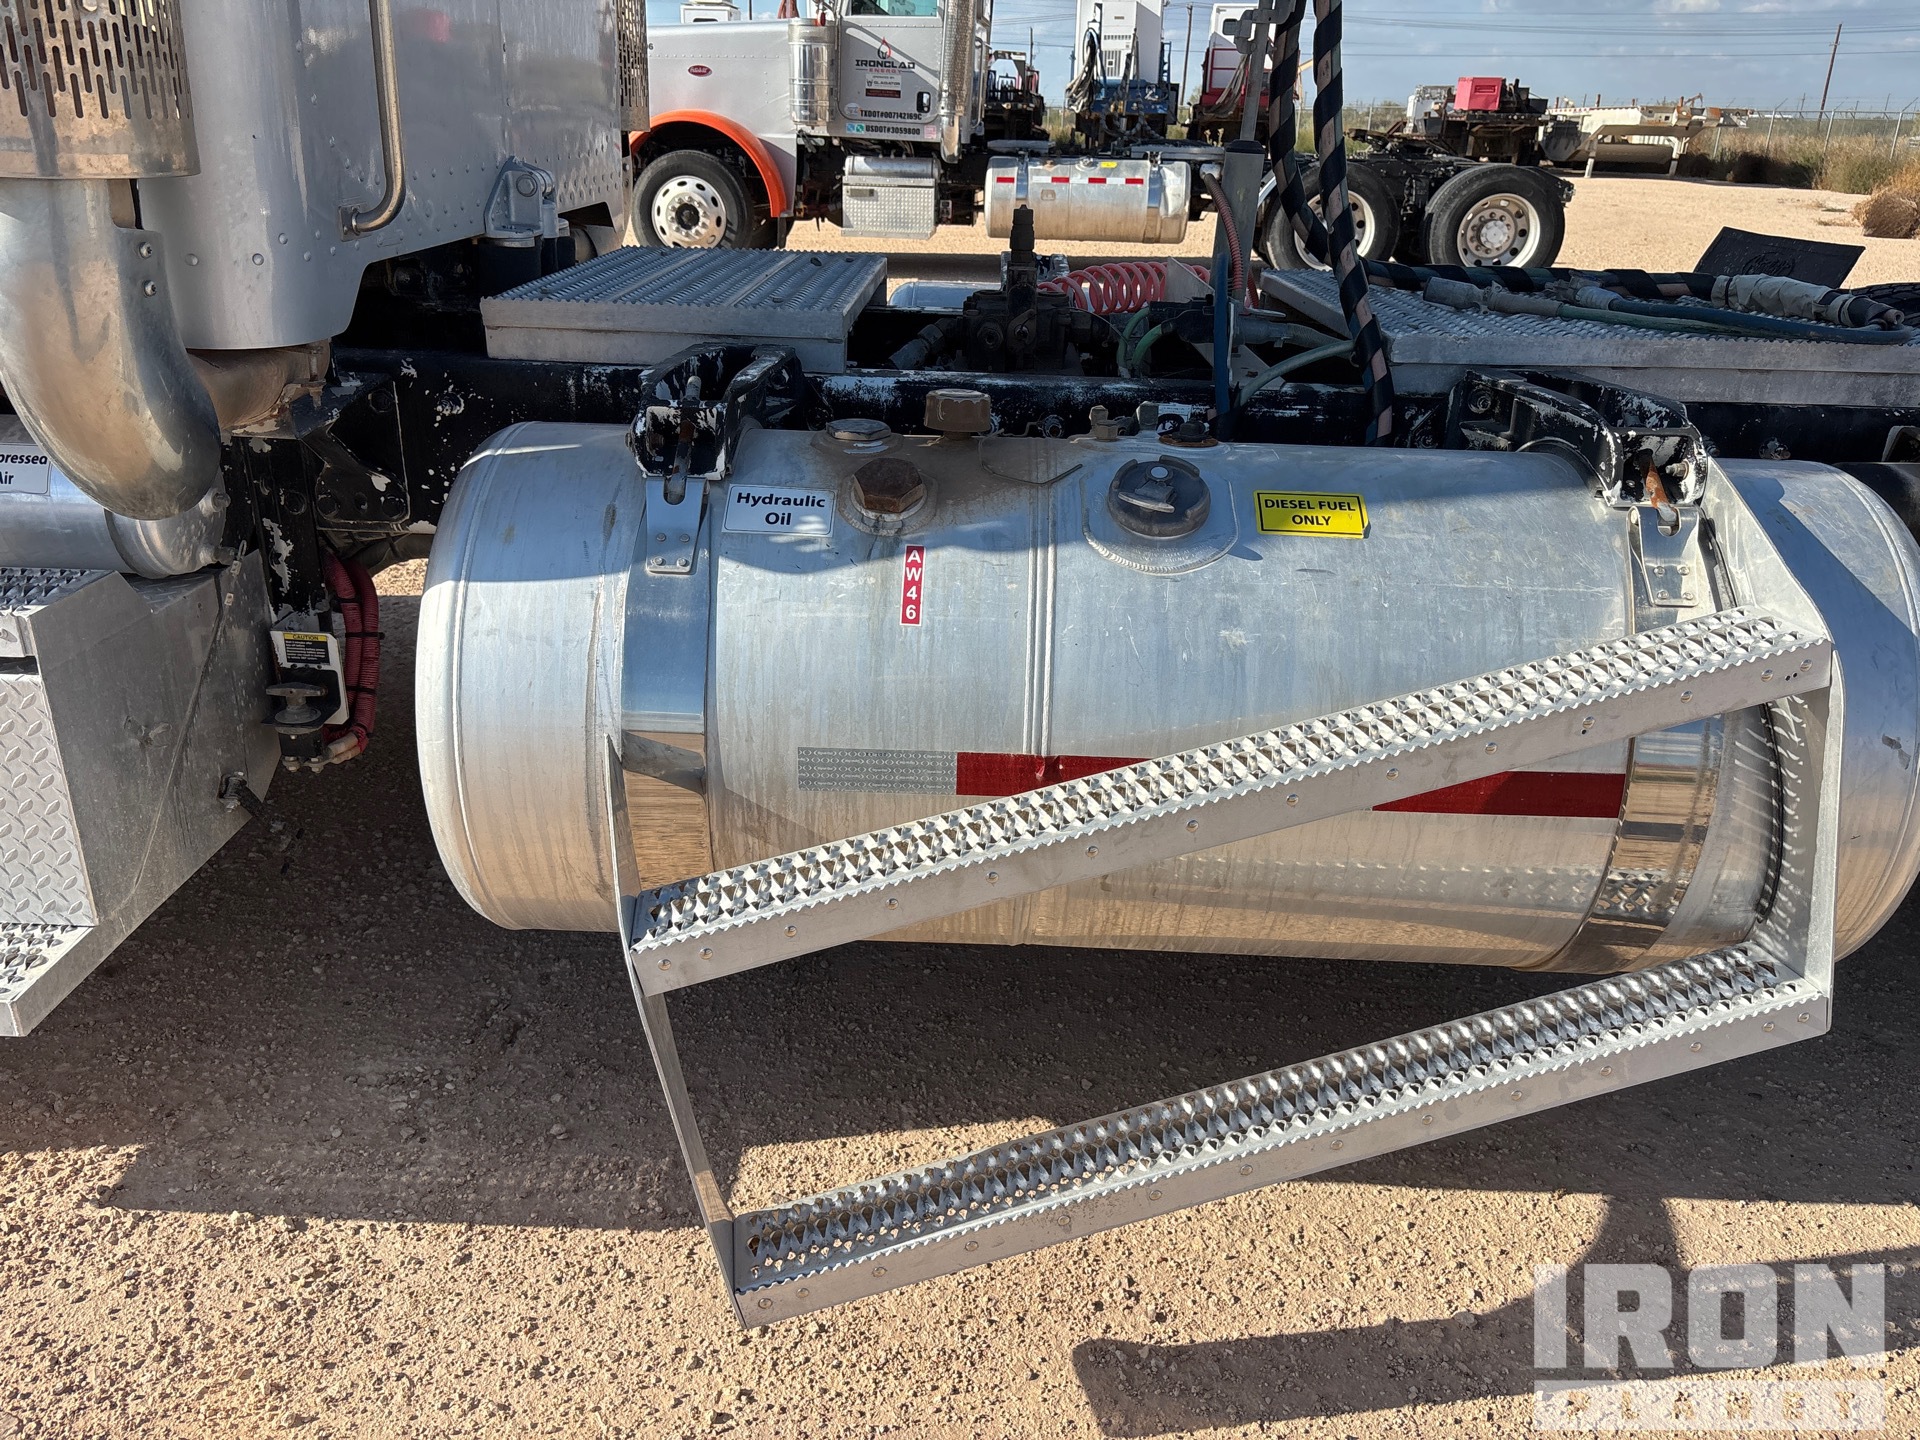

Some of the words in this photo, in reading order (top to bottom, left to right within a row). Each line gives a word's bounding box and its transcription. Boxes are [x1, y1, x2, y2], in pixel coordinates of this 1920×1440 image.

[855, 59, 916, 69] IRONCLAD
[865, 125, 921, 135] USDOT#3059800
[736, 492, 826, 508] Hydraulic
[1264, 498, 1315, 510] DIESEL
[1318, 500, 1356, 512] FUEL
[765, 512, 791, 526] Oil
[1291, 514, 1331, 526] ONLY
